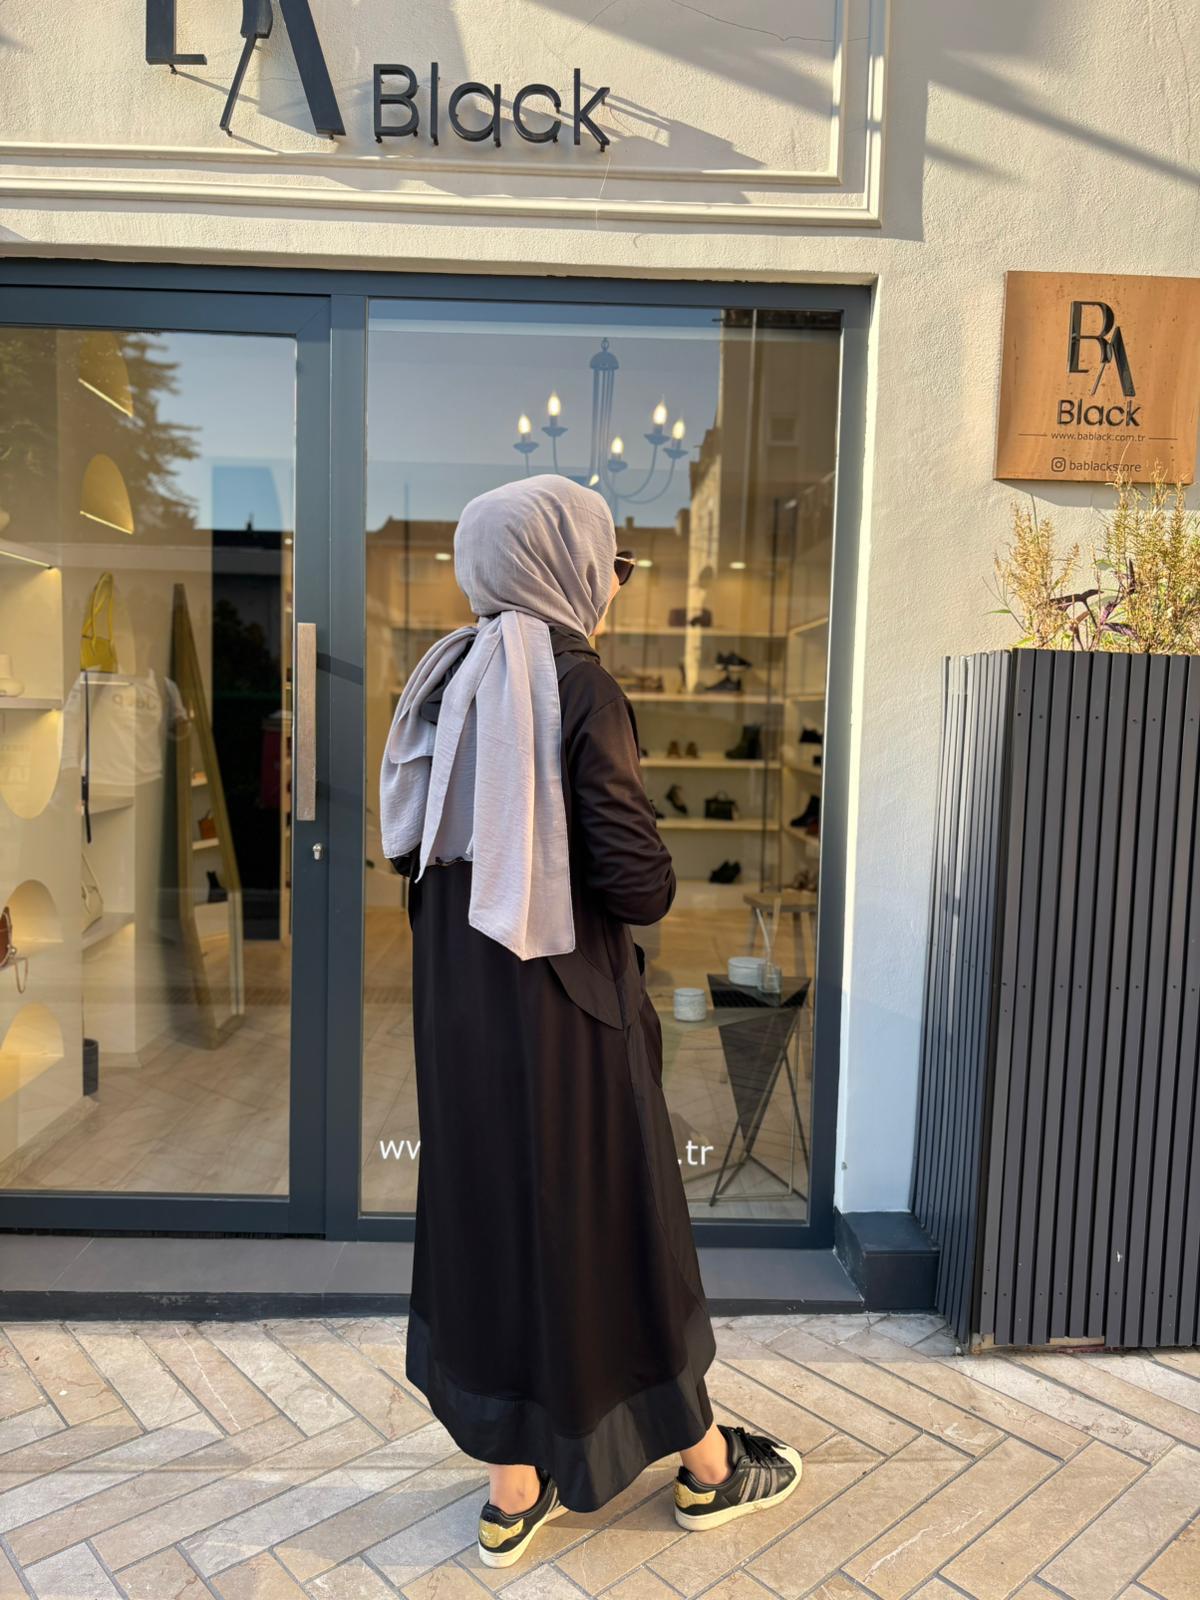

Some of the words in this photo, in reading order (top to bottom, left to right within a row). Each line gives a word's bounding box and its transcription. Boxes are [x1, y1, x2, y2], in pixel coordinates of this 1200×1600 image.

[373, 62, 609, 148] Black
[1057, 399, 1141, 427] Black
[1051, 432, 1145, 442] www.bablack.com.tr
